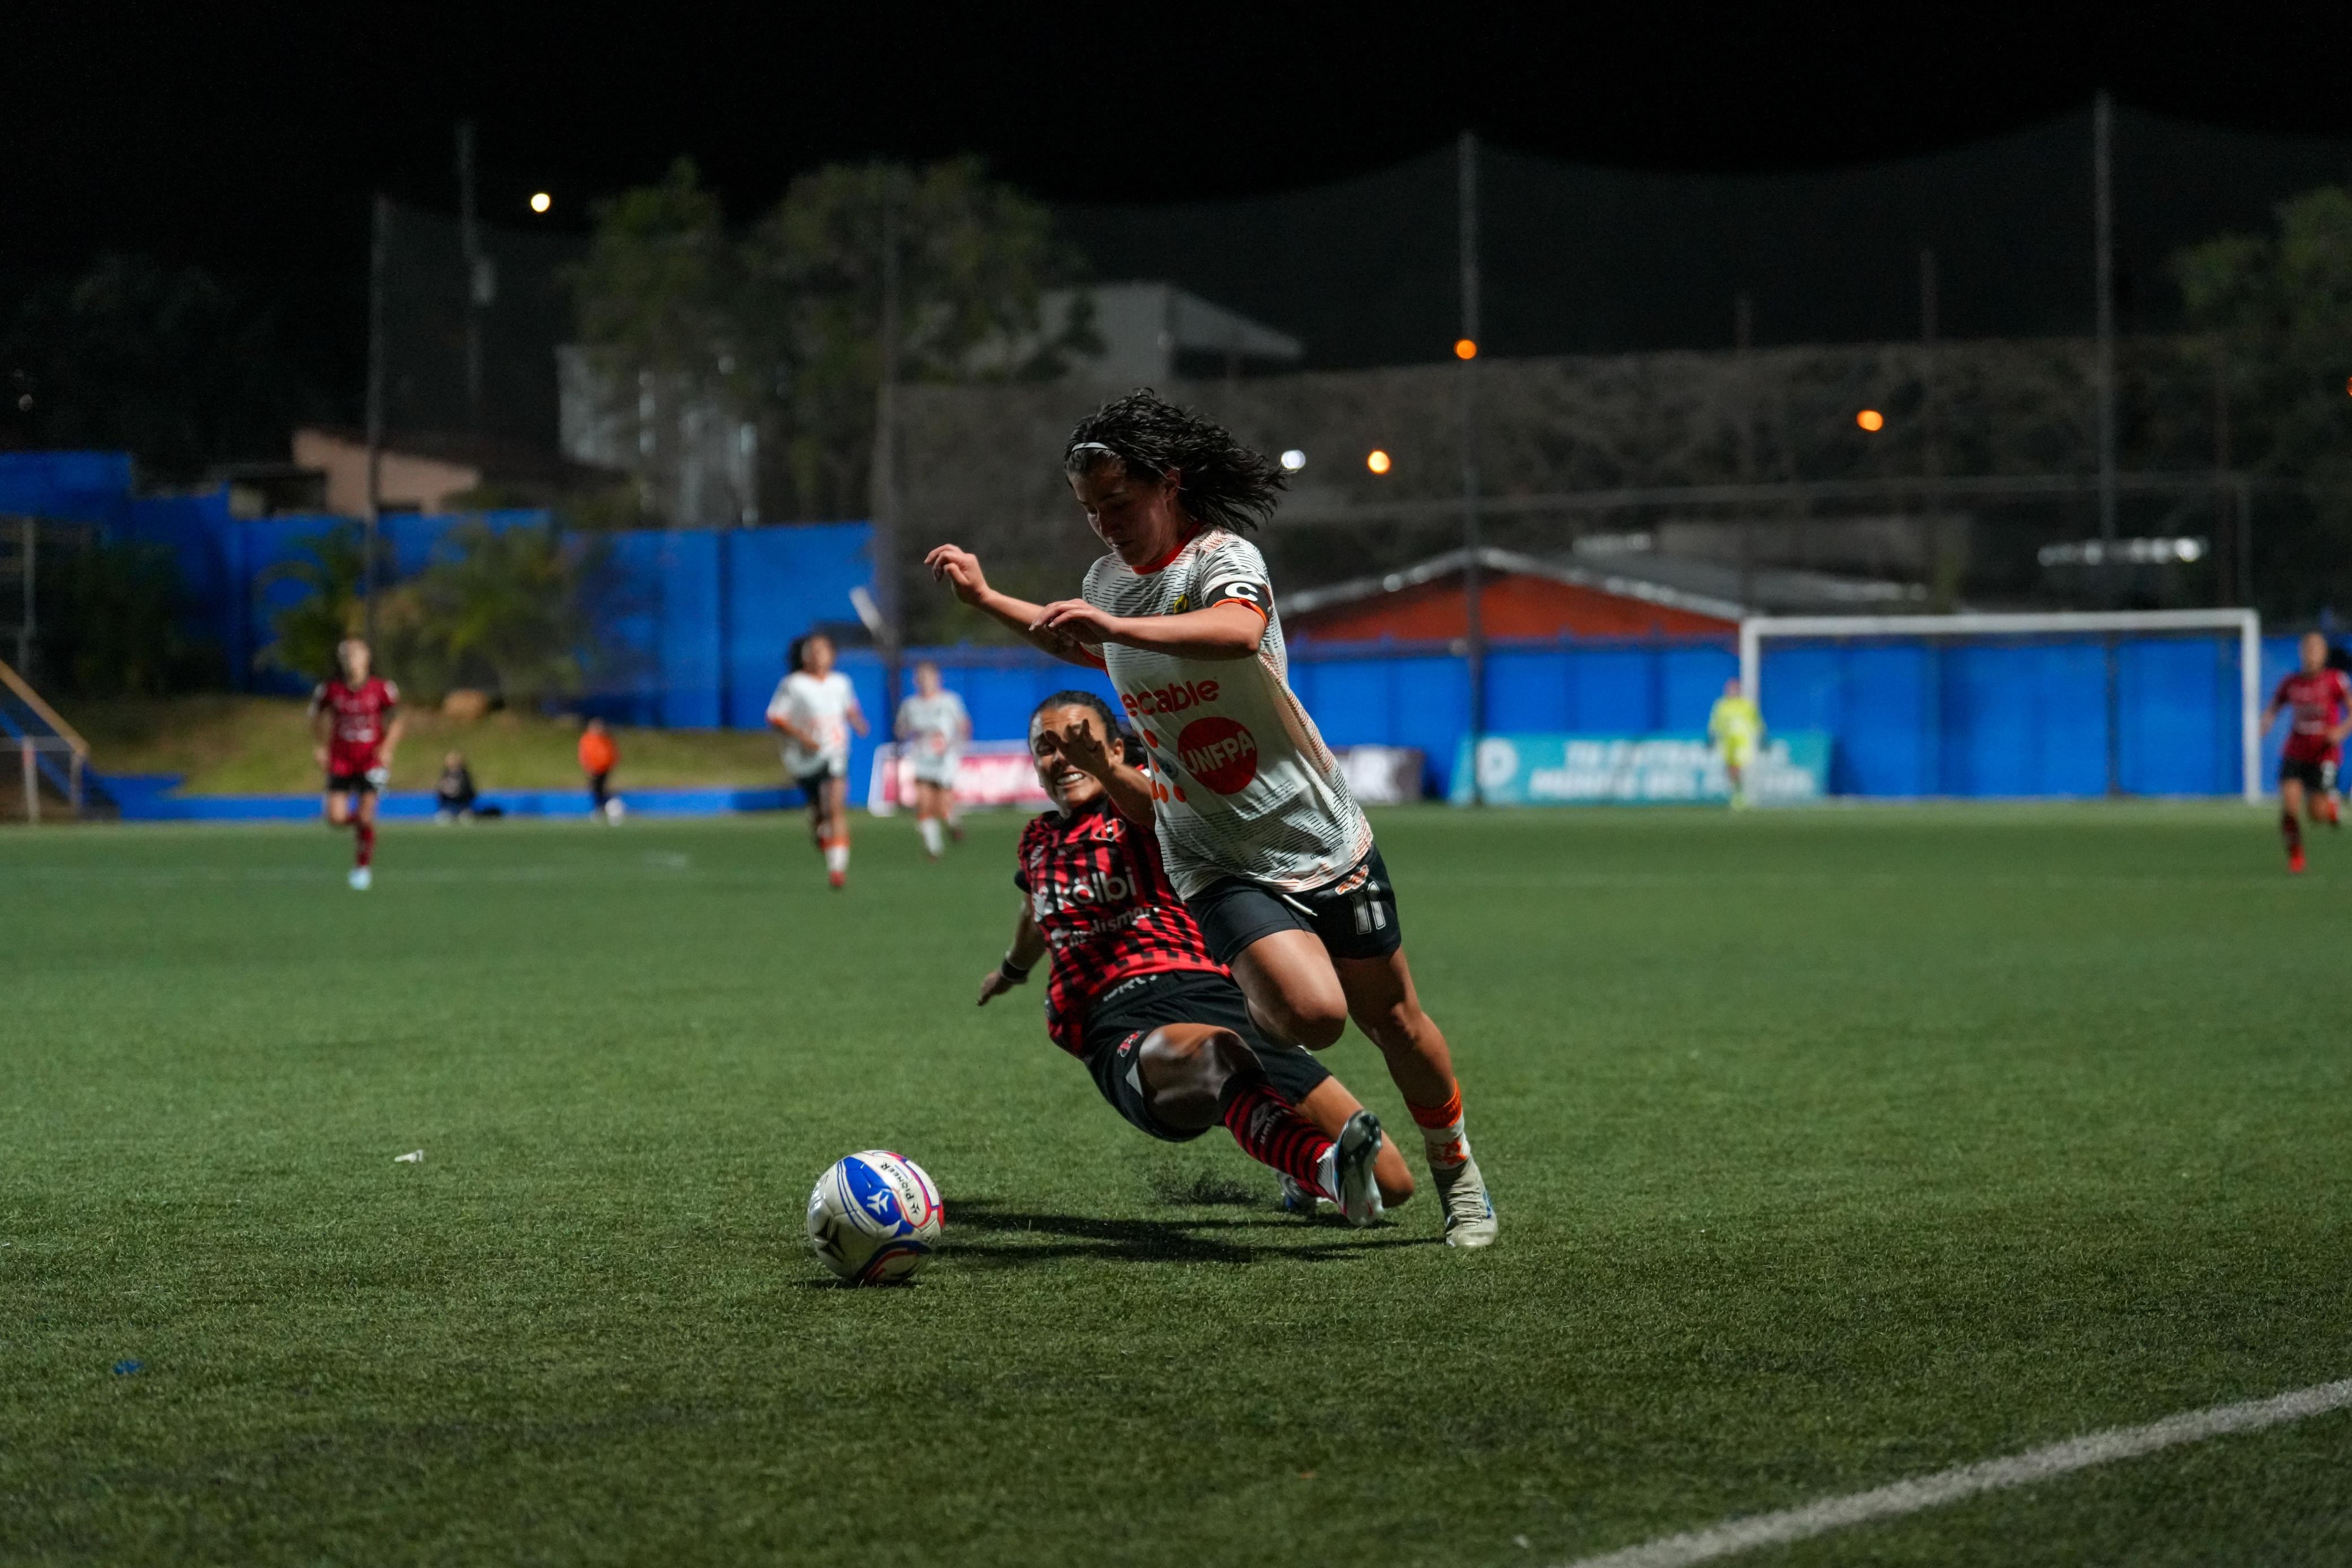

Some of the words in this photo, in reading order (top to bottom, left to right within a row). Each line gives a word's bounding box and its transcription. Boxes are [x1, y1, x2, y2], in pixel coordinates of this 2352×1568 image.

[1225, 582, 1258, 601] C
[1179, 730, 1256, 774] UNFPA
[1349, 881, 1386, 935] 11
[880, 1162, 914, 1200] PIONEER
